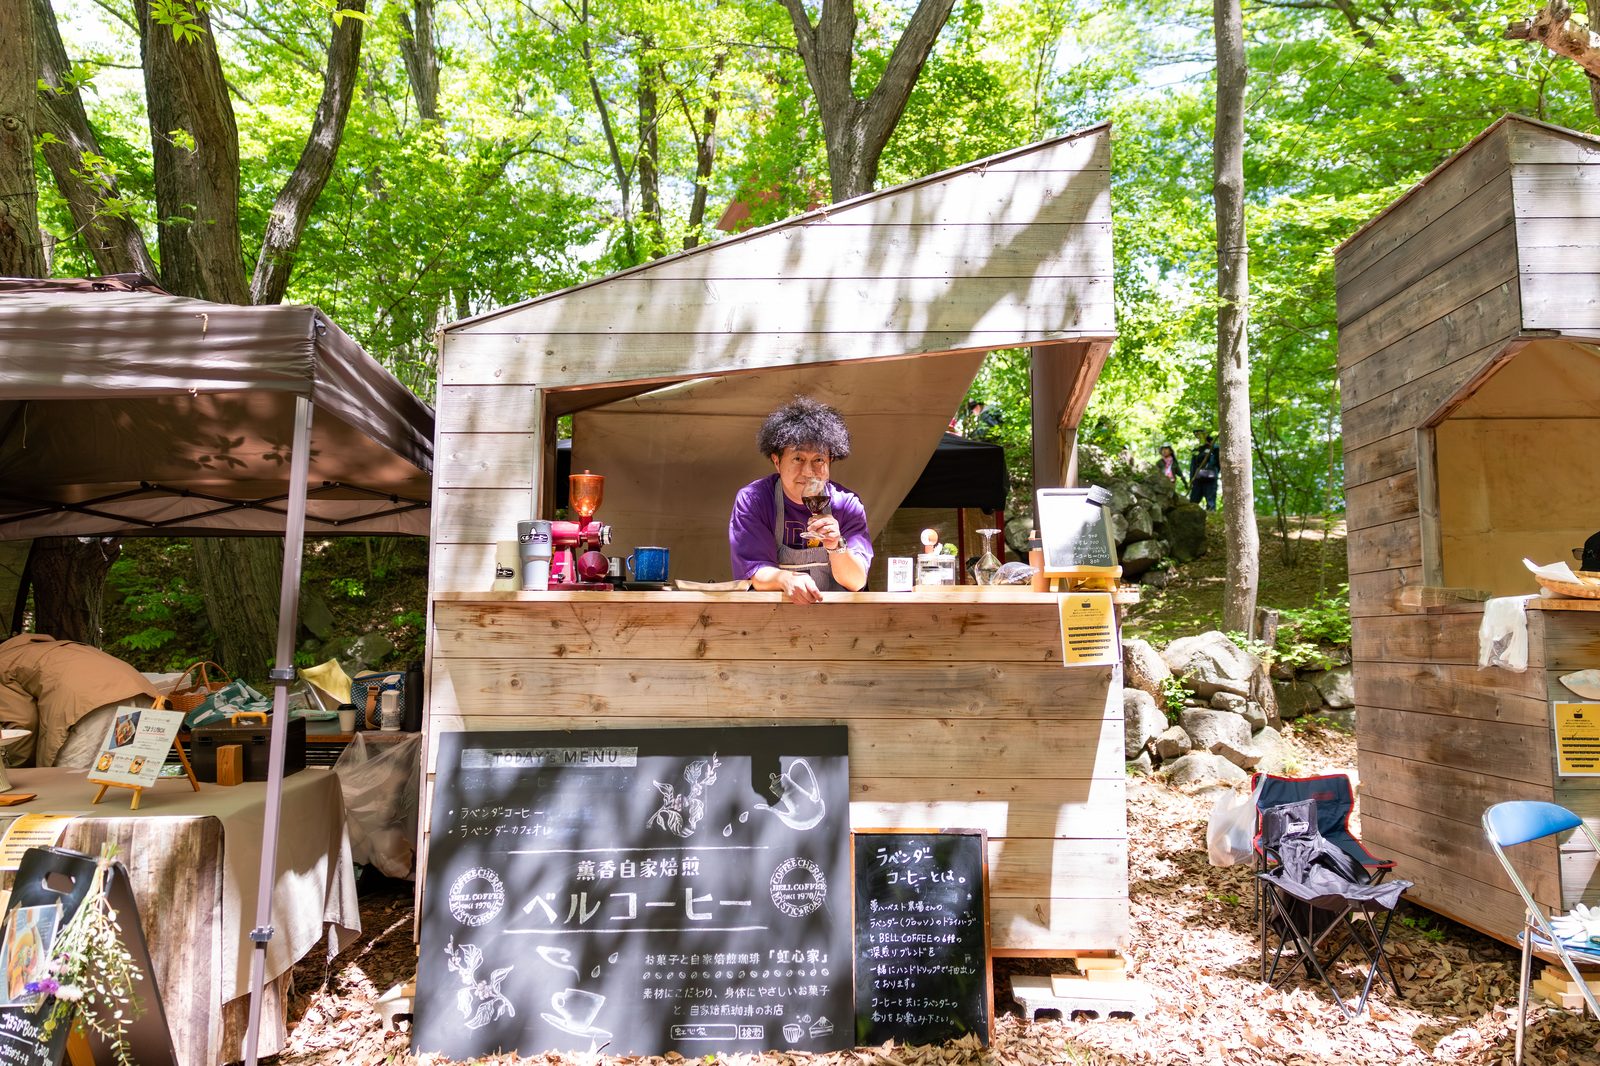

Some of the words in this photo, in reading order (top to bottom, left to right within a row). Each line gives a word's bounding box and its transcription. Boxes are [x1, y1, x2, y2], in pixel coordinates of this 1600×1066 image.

[564, 750, 618, 763] MENU
[461, 807, 544, 819] ラベンダーコーヒー
[876, 847, 934, 866] ラベンダー
[576, 856, 700, 881] 薫香自家焙煎
[522, 888, 752, 924] ベルコーヒー
[879, 933, 899, 943] BELL
